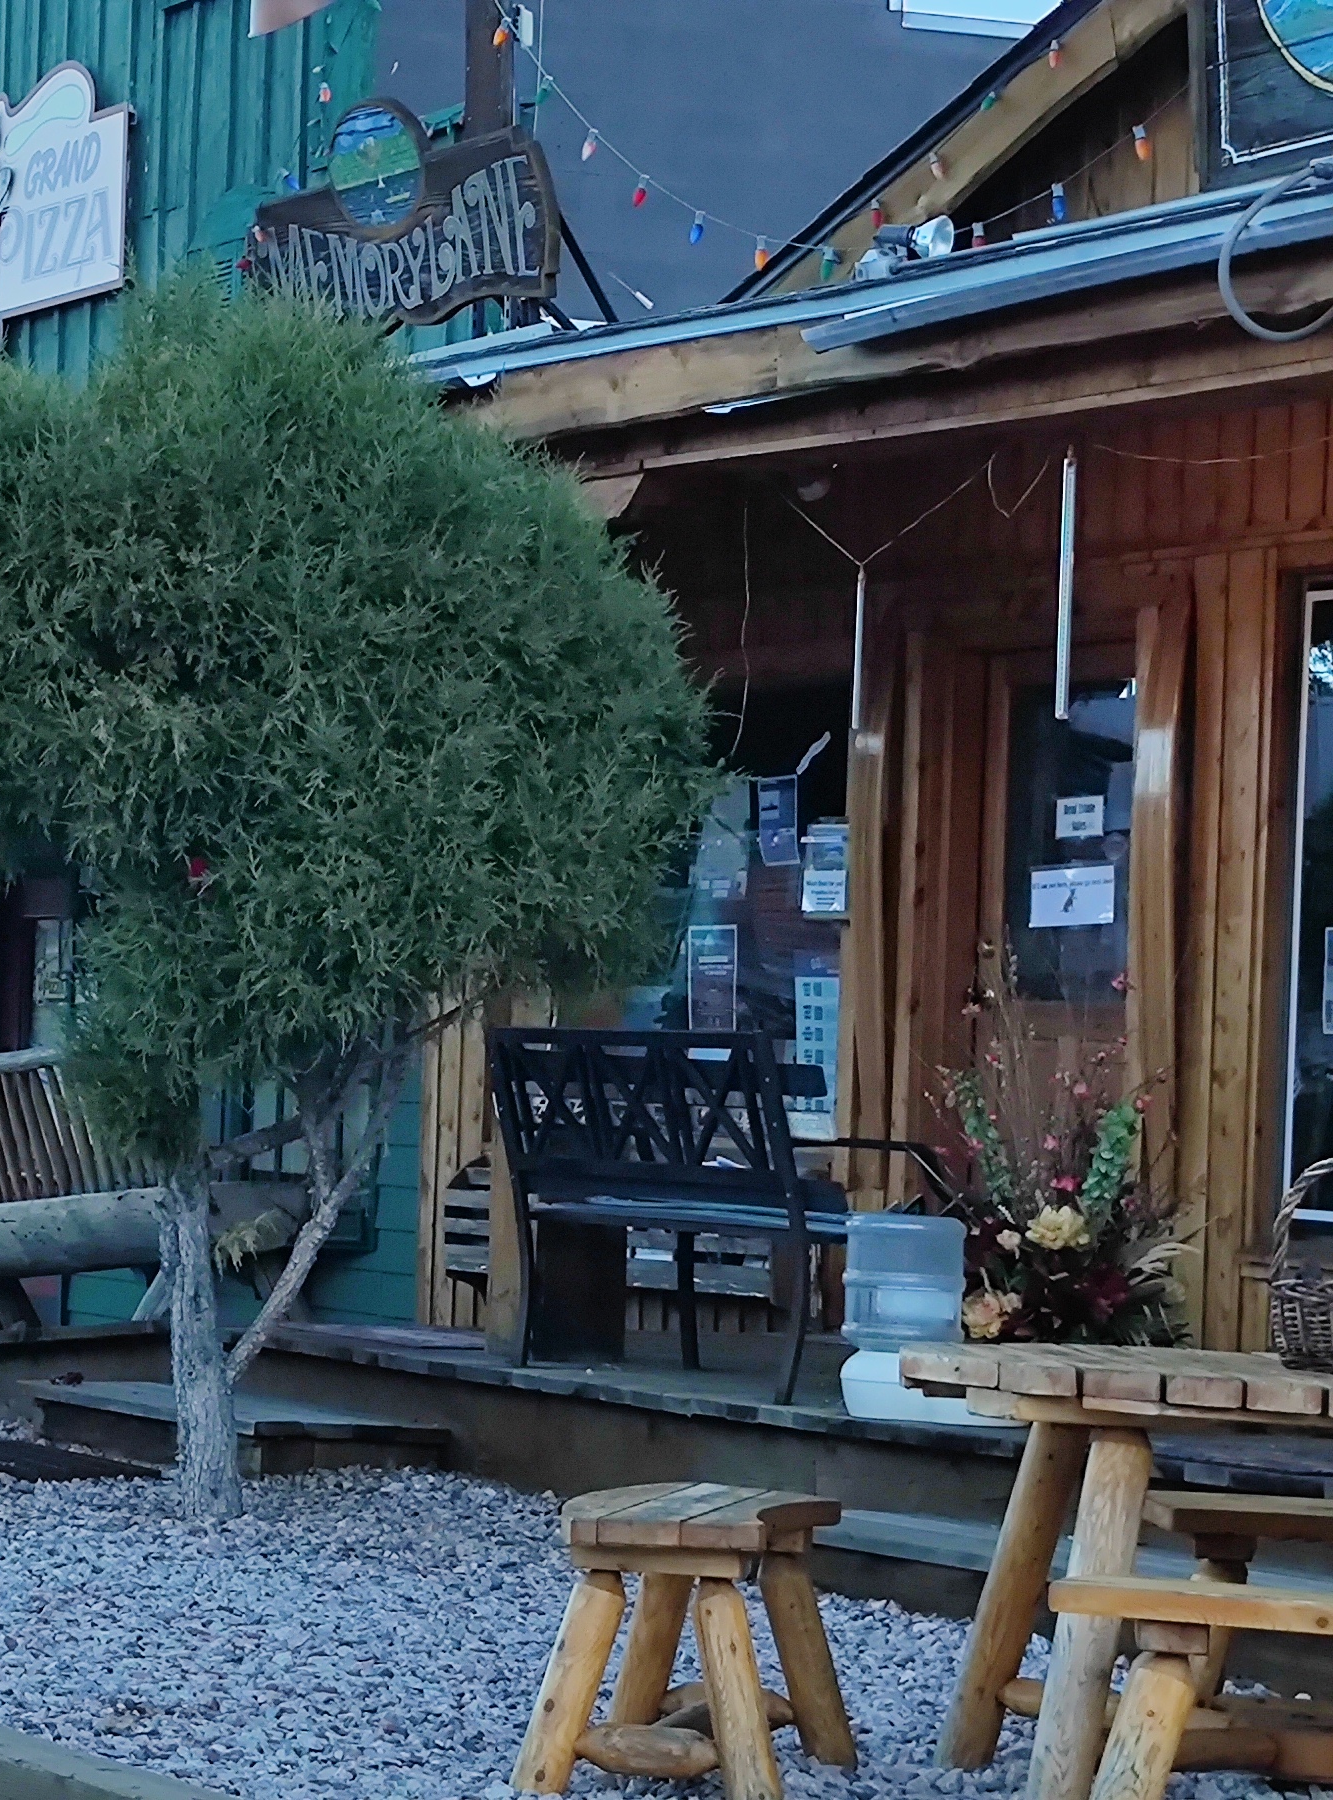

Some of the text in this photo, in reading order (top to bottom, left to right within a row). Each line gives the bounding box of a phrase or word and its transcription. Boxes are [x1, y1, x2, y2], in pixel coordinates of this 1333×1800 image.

[24, 131, 101, 199] GRAND
[259, 155, 540, 319] MEMORY LANE
